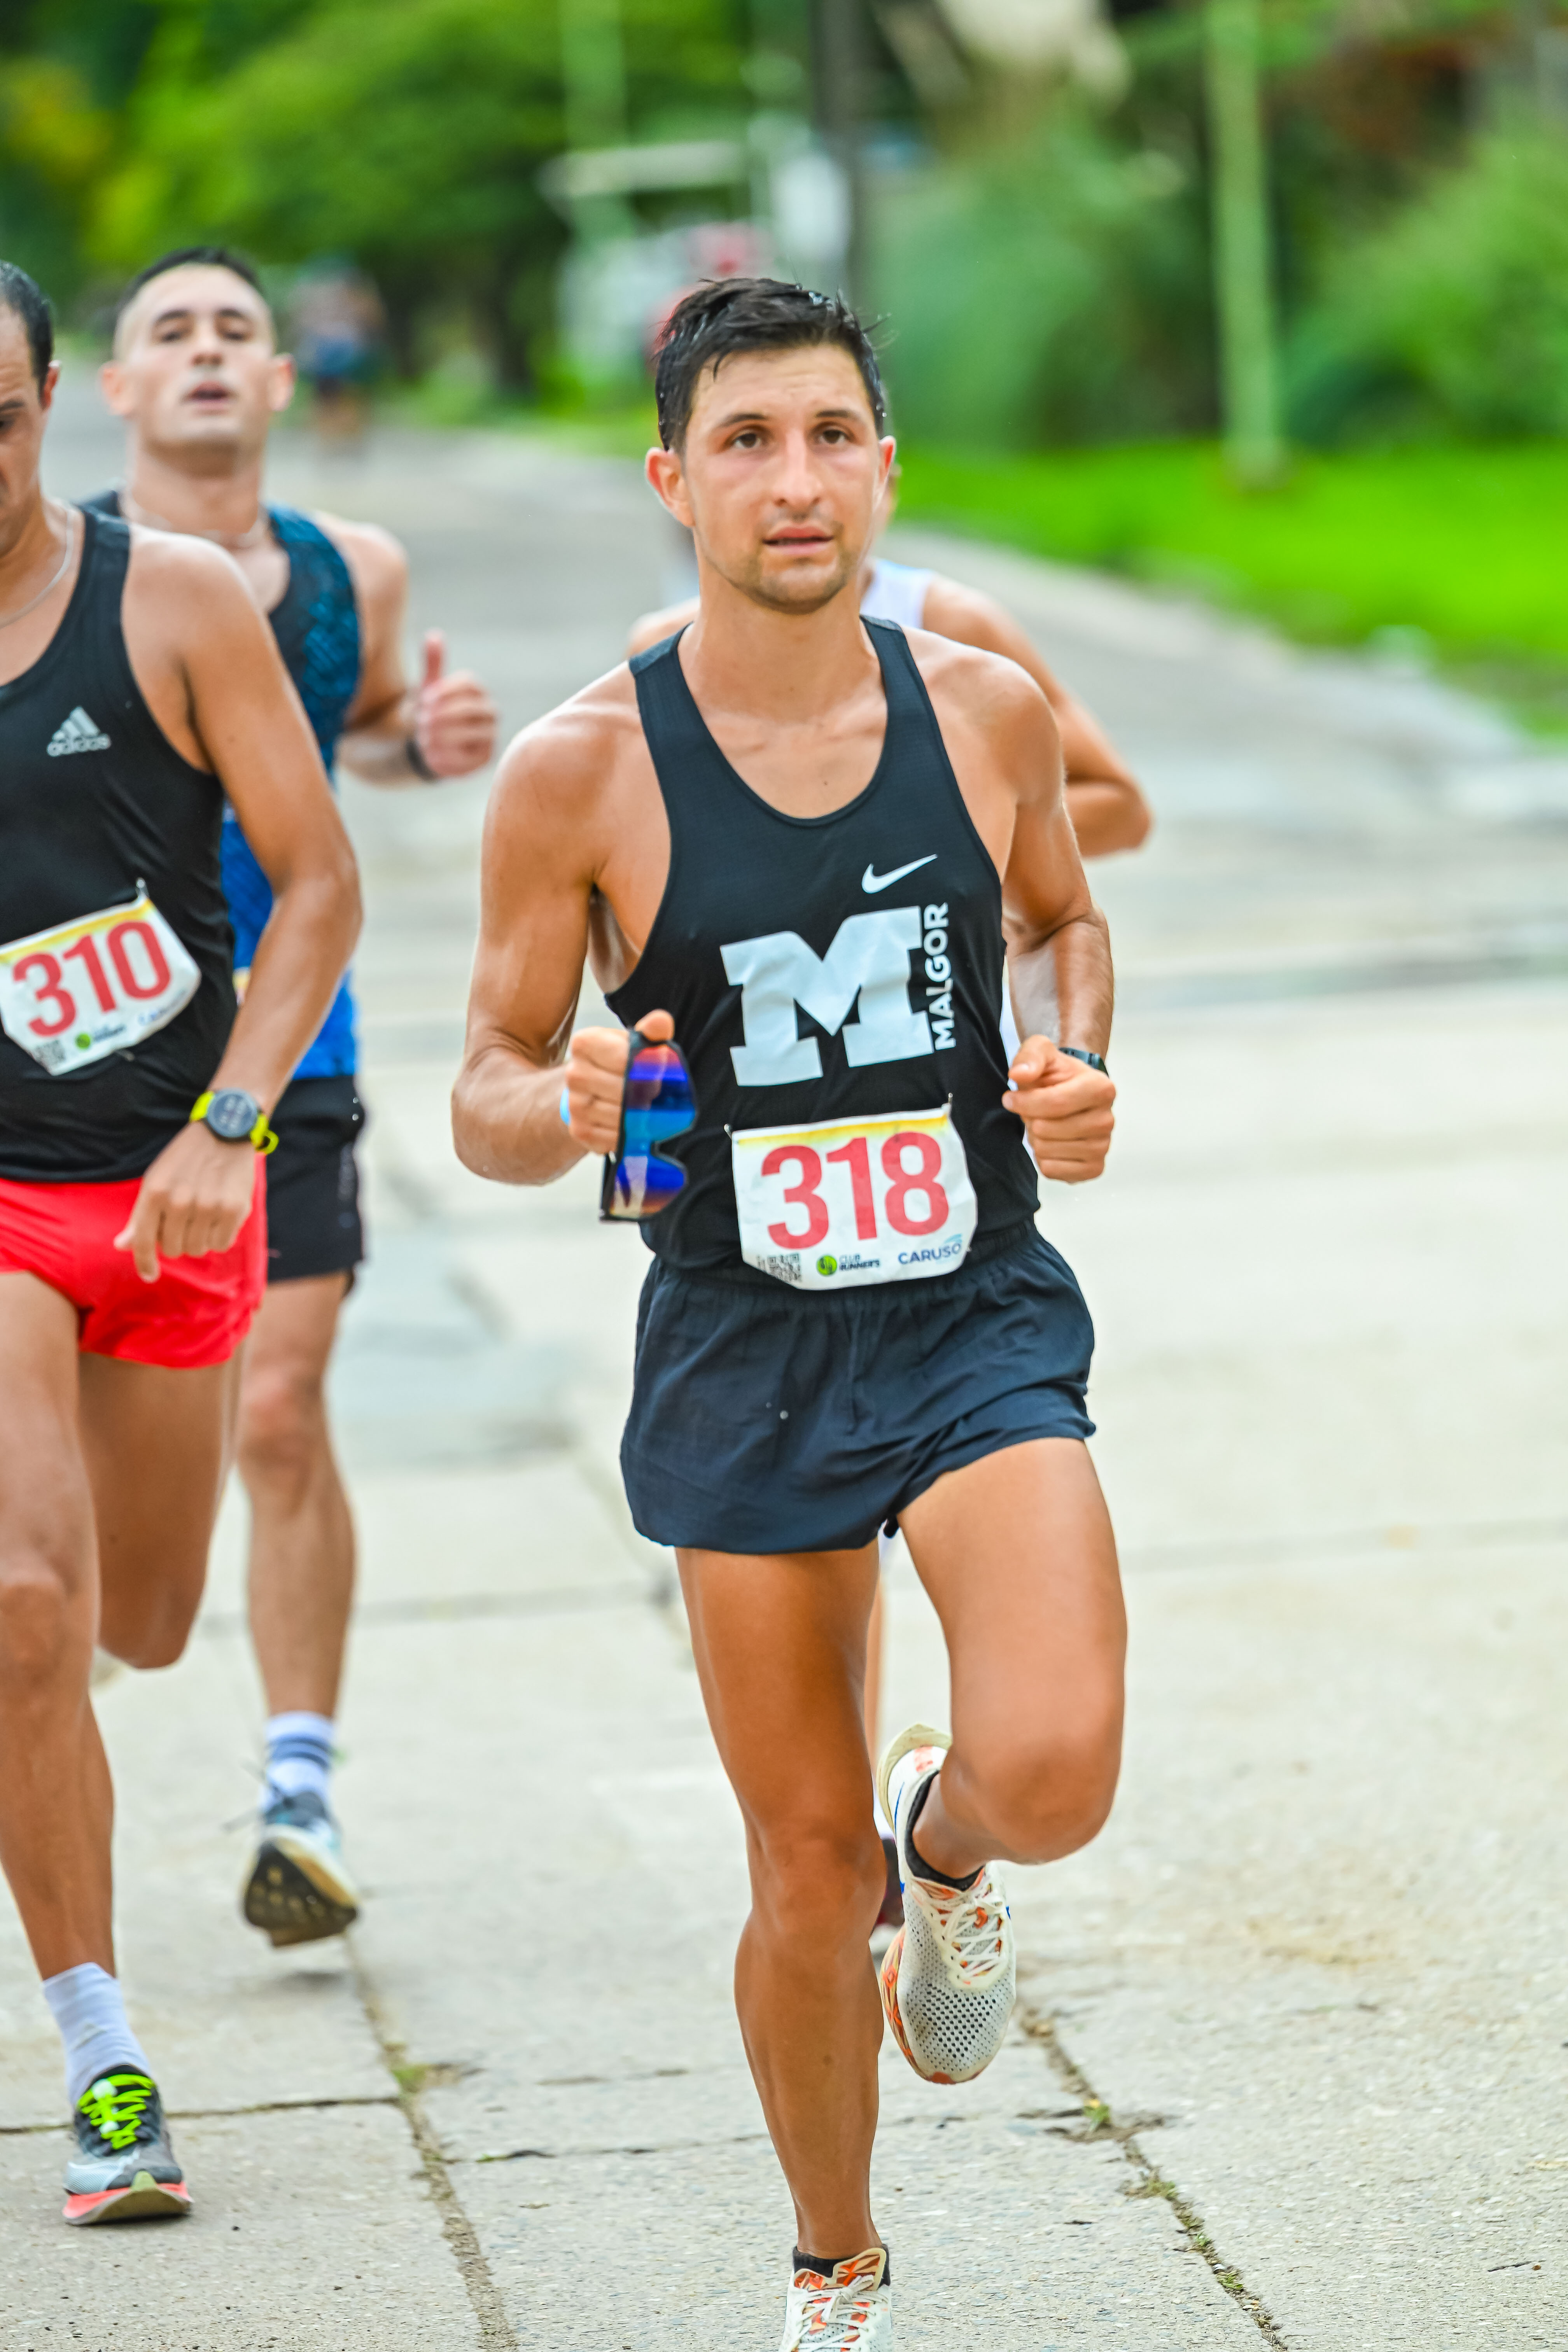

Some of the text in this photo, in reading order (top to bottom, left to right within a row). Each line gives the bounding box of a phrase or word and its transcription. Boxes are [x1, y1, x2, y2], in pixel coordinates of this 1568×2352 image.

[46, 733, 112, 757] adidas
[12, 919, 171, 1037] 310
[720, 905, 934, 1086] M
[923, 902, 956, 1050] MALGOR
[760, 1131, 950, 1250] 318
[898, 1243, 961, 1264] CARUSO
